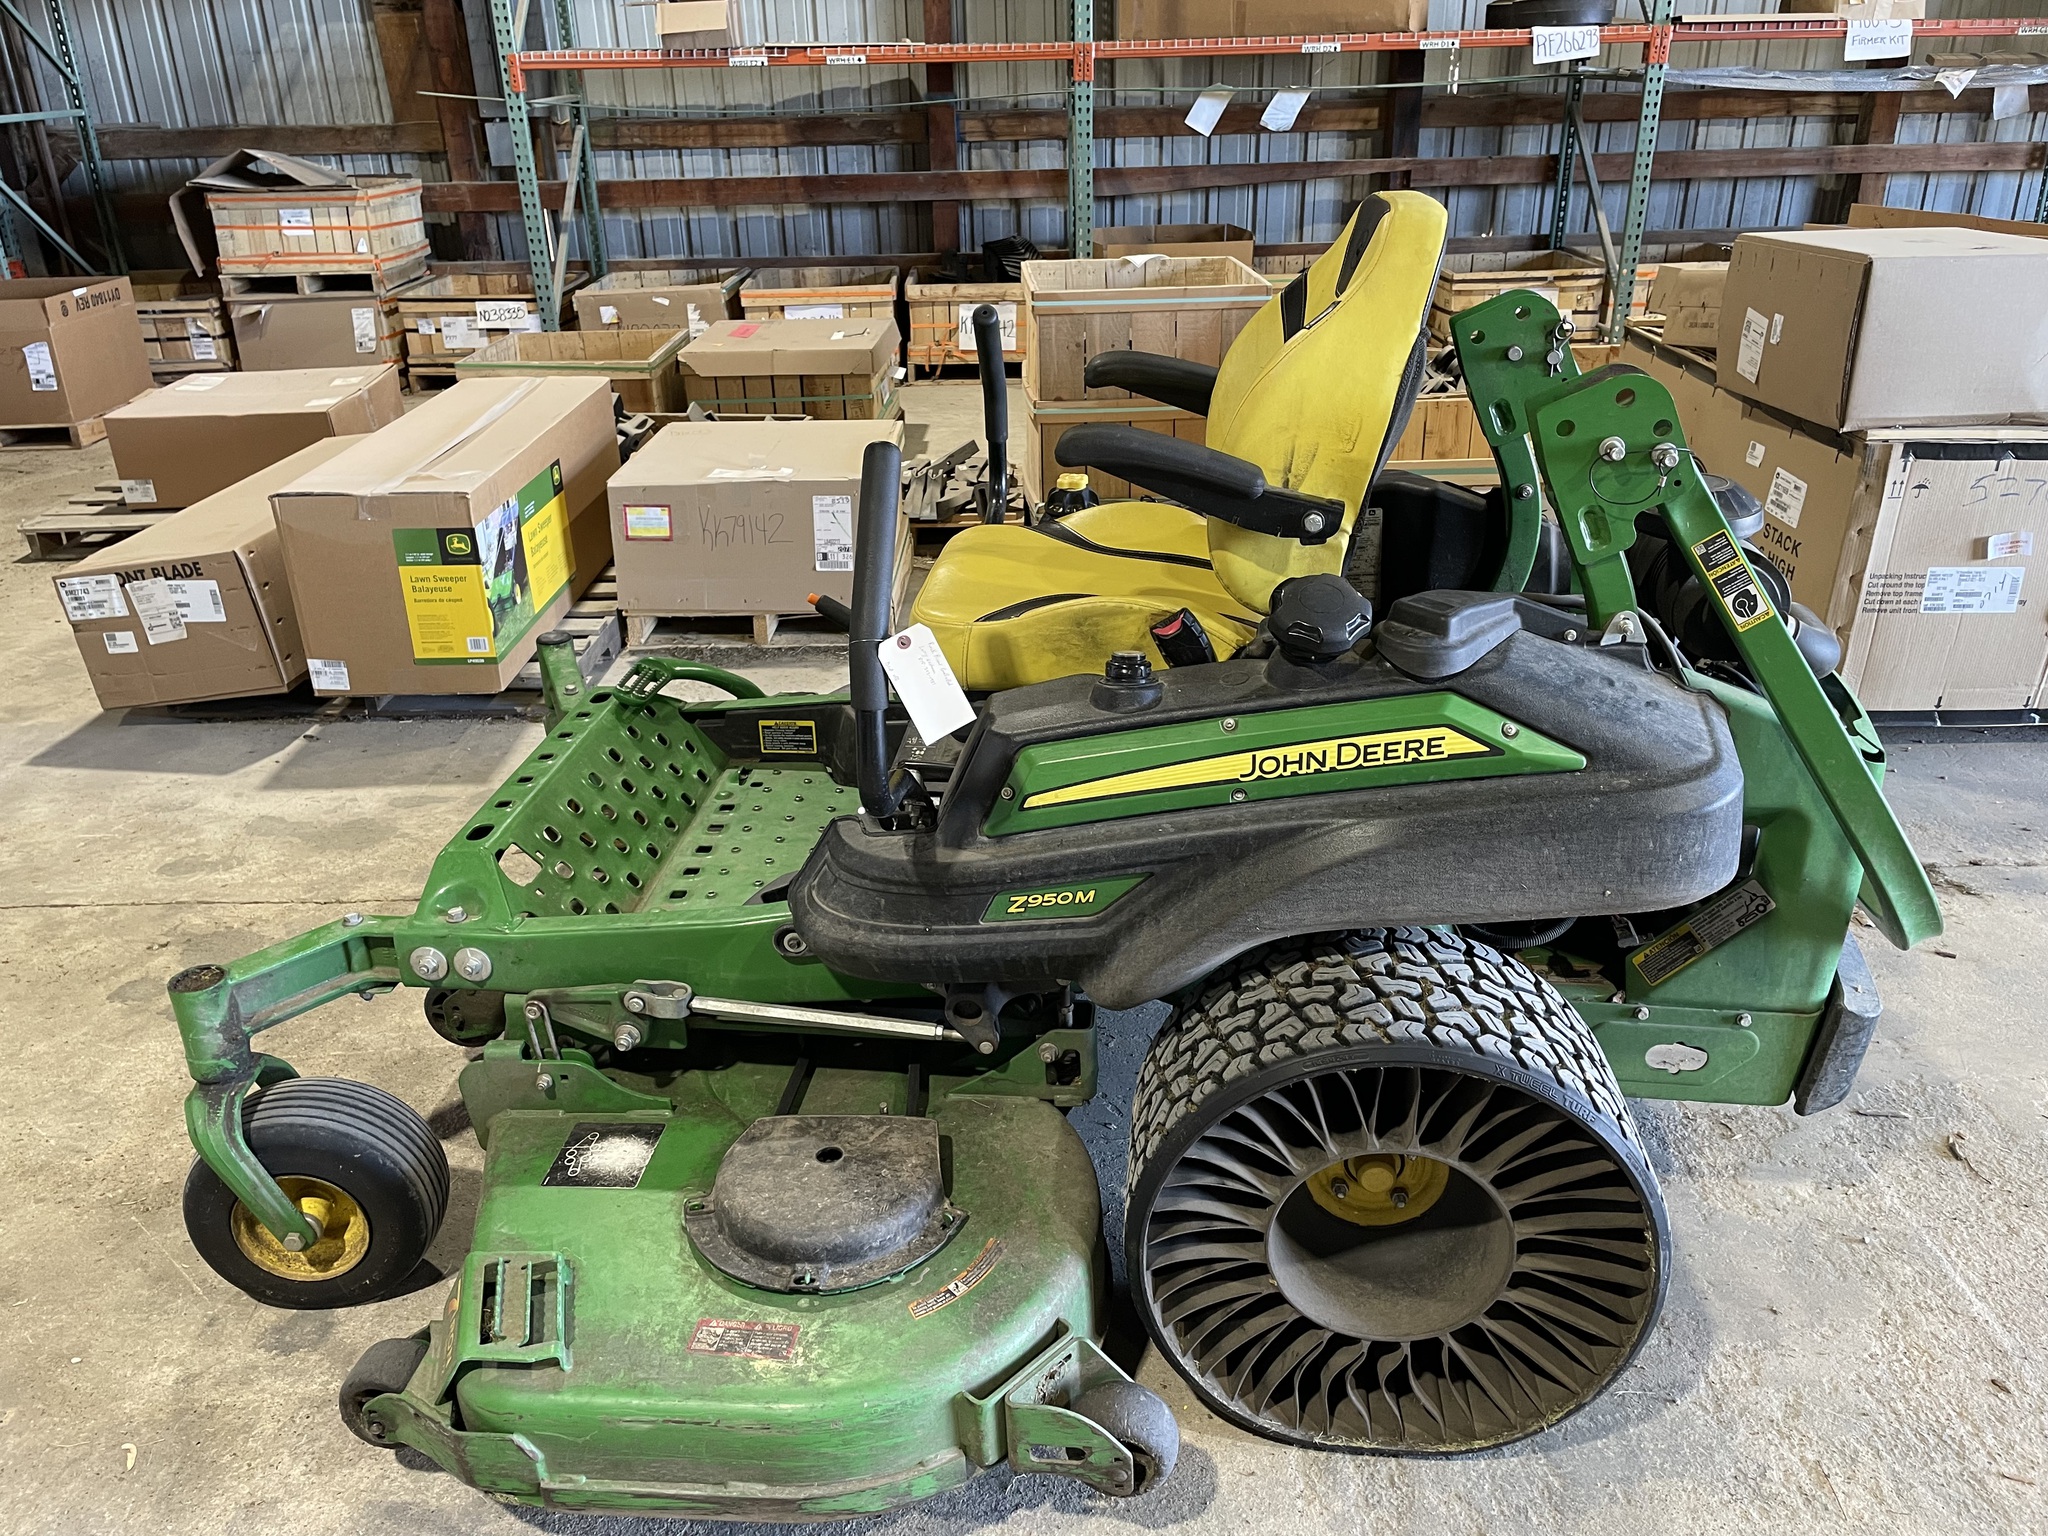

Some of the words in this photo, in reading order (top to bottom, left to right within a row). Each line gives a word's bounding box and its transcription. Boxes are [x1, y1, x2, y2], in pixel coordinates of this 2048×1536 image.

[1536, 29, 1598, 56] RE266293
[1852, 35, 1887, 46] FIRMER
[1889, 35, 1908, 45] KIT
[1763, 523, 1803, 558] STACK
[151, 562, 204, 582] BLADE
[1768, 550, 1796, 581] HIGH
[410, 575, 431, 583] Lawn
[433, 574, 467, 584] Sweeper
[1869, 573, 1902, 581] Unpacking
[412, 585, 452, 594] Balayeuse
[1740, 612, 1768, 630] CAUTION
[1239, 750, 1327, 779] JOHN
[1336, 736, 1446, 767] DEERE
[1007, 889, 1096, 913] Z950M
[1510, 1070, 1559, 1100] TWEEL
[1563, 1094, 1597, 1124] TURF
